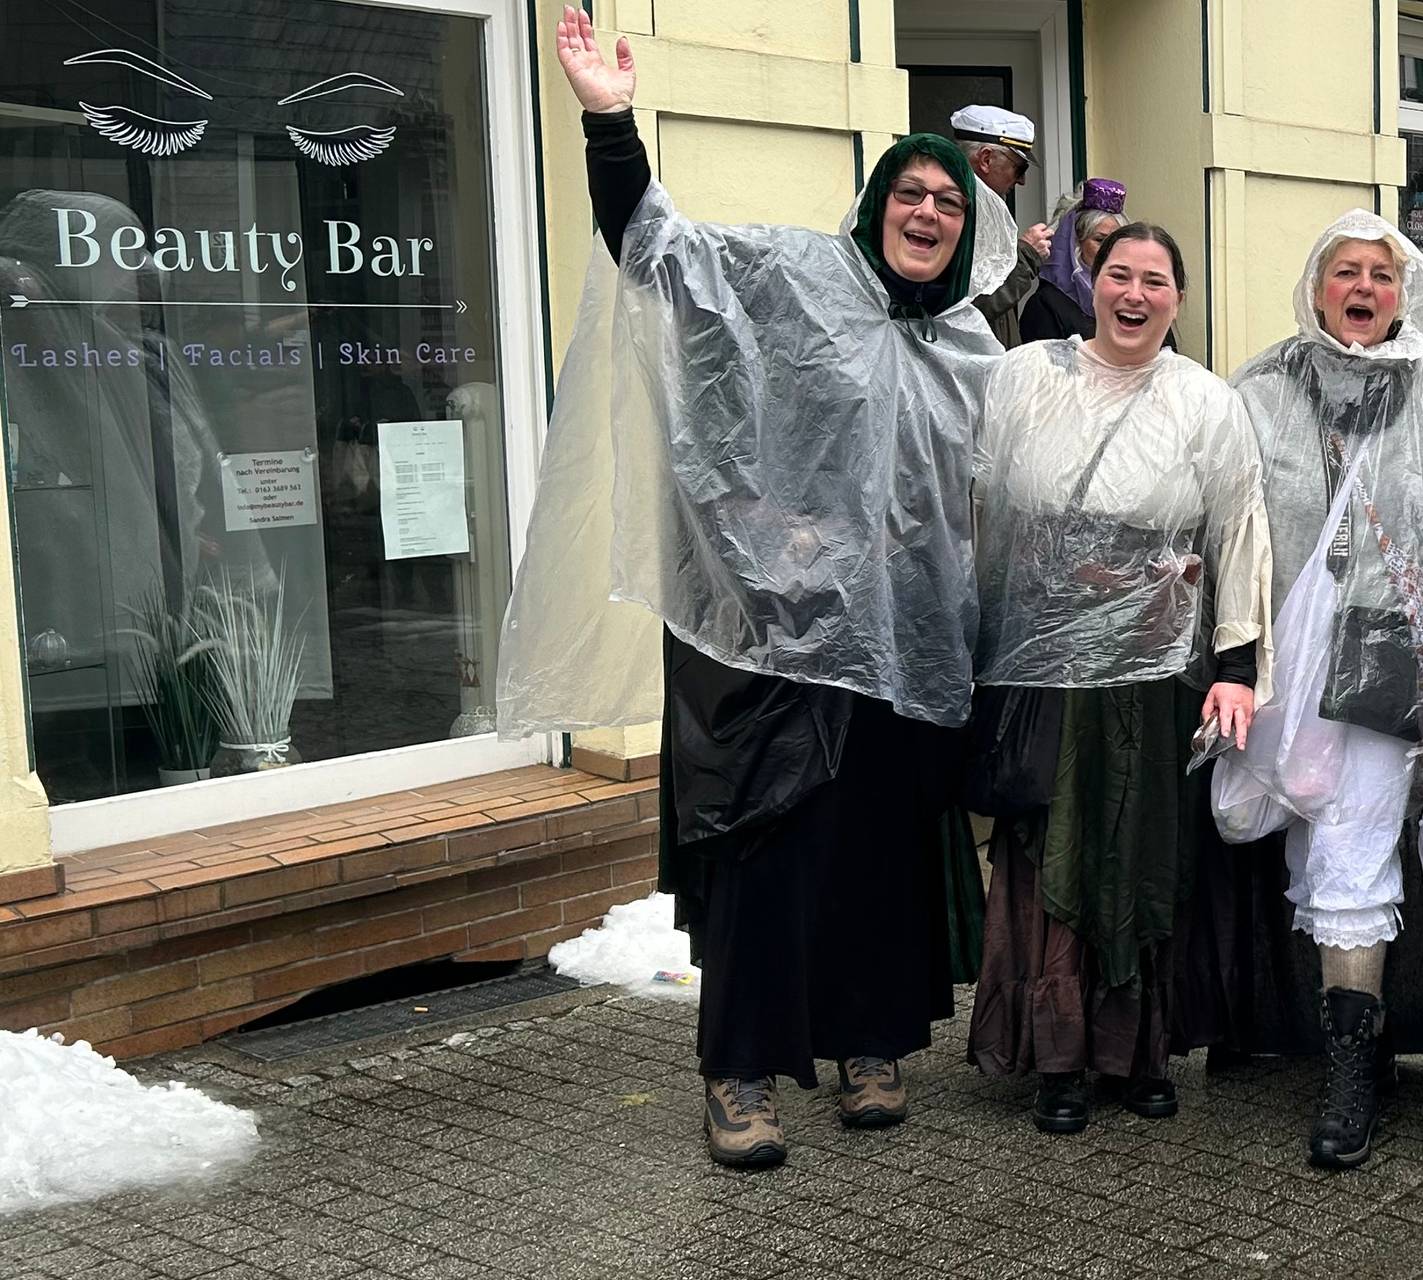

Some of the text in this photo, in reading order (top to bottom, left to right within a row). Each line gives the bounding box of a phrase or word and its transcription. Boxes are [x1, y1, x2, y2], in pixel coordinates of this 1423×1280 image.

[50, 207, 434, 293] Beauty Bar
[11, 342, 477, 368] Lashes Facials Skin Care
[252, 458, 283, 466] Termine
[236, 466, 300, 477] nach Vereinbarung
